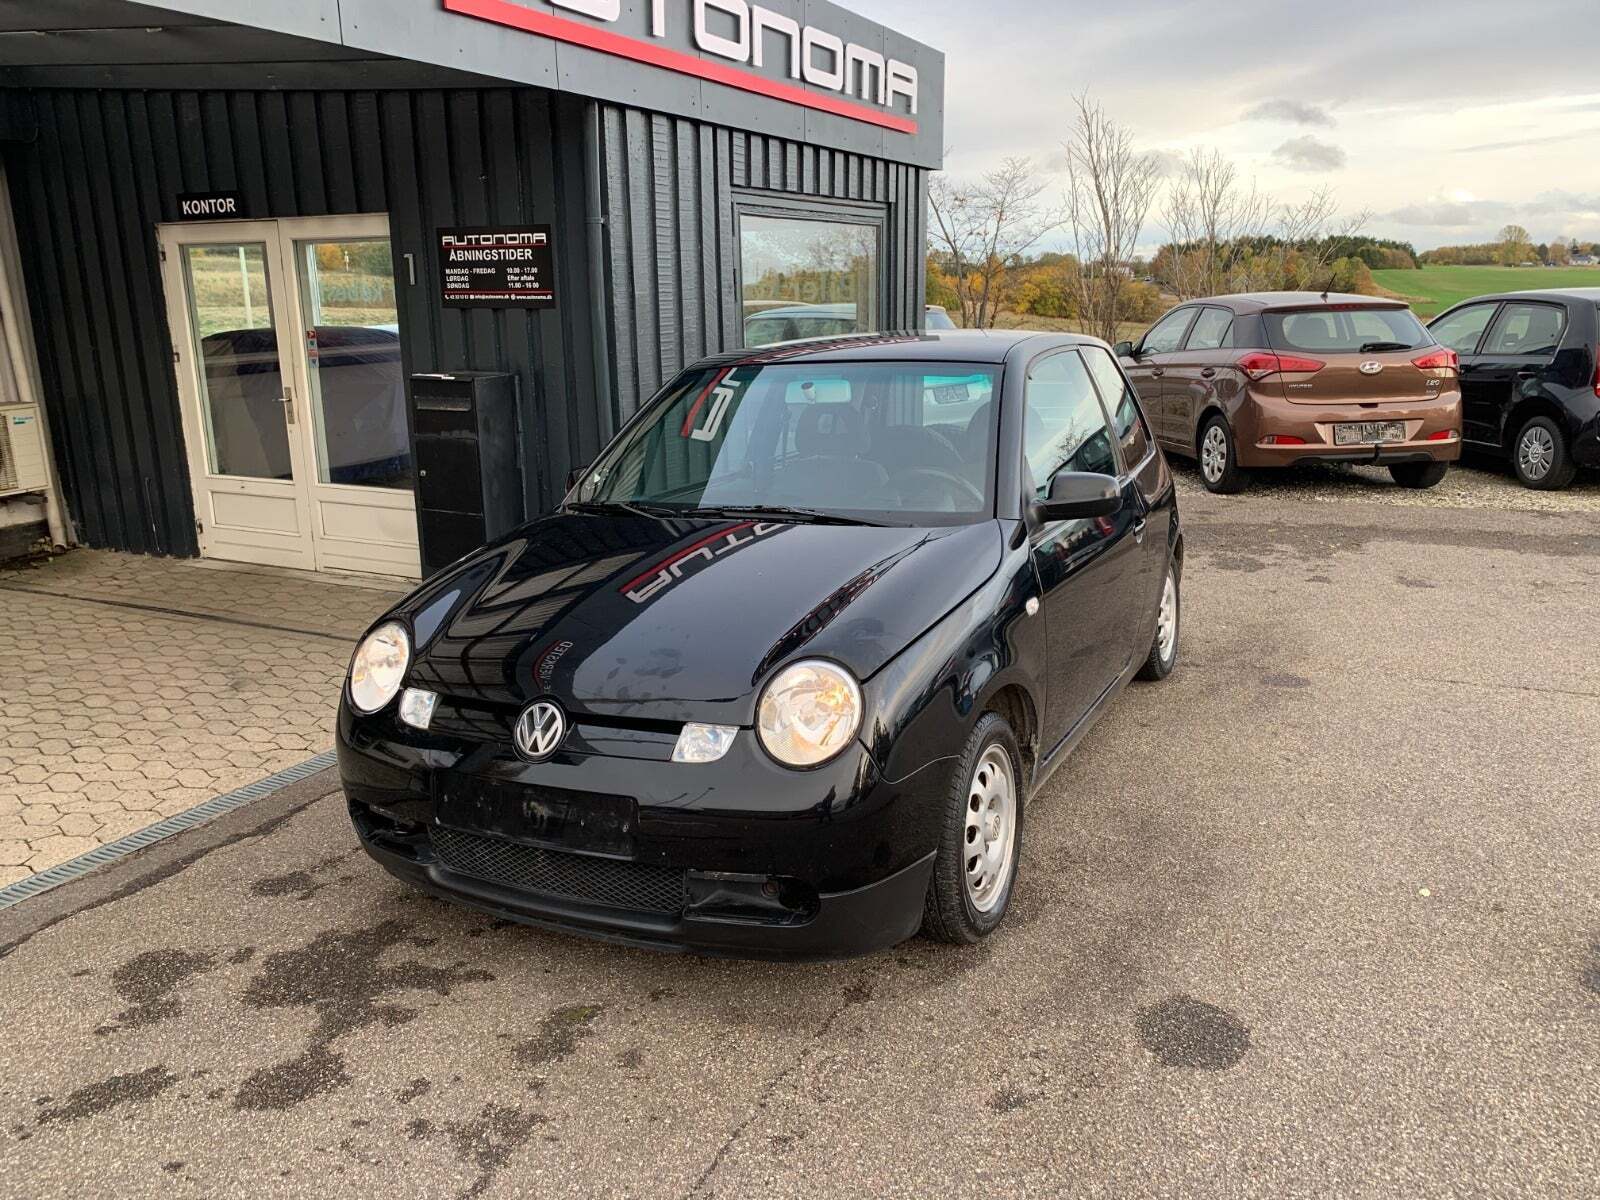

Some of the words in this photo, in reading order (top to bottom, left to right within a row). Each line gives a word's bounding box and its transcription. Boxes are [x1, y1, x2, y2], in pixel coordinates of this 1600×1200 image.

[182, 198, 236, 215] KONTOR
[442, 232, 547, 246] AUTONOMA
[449, 248, 533, 262] ÅBNINGSTIDER
